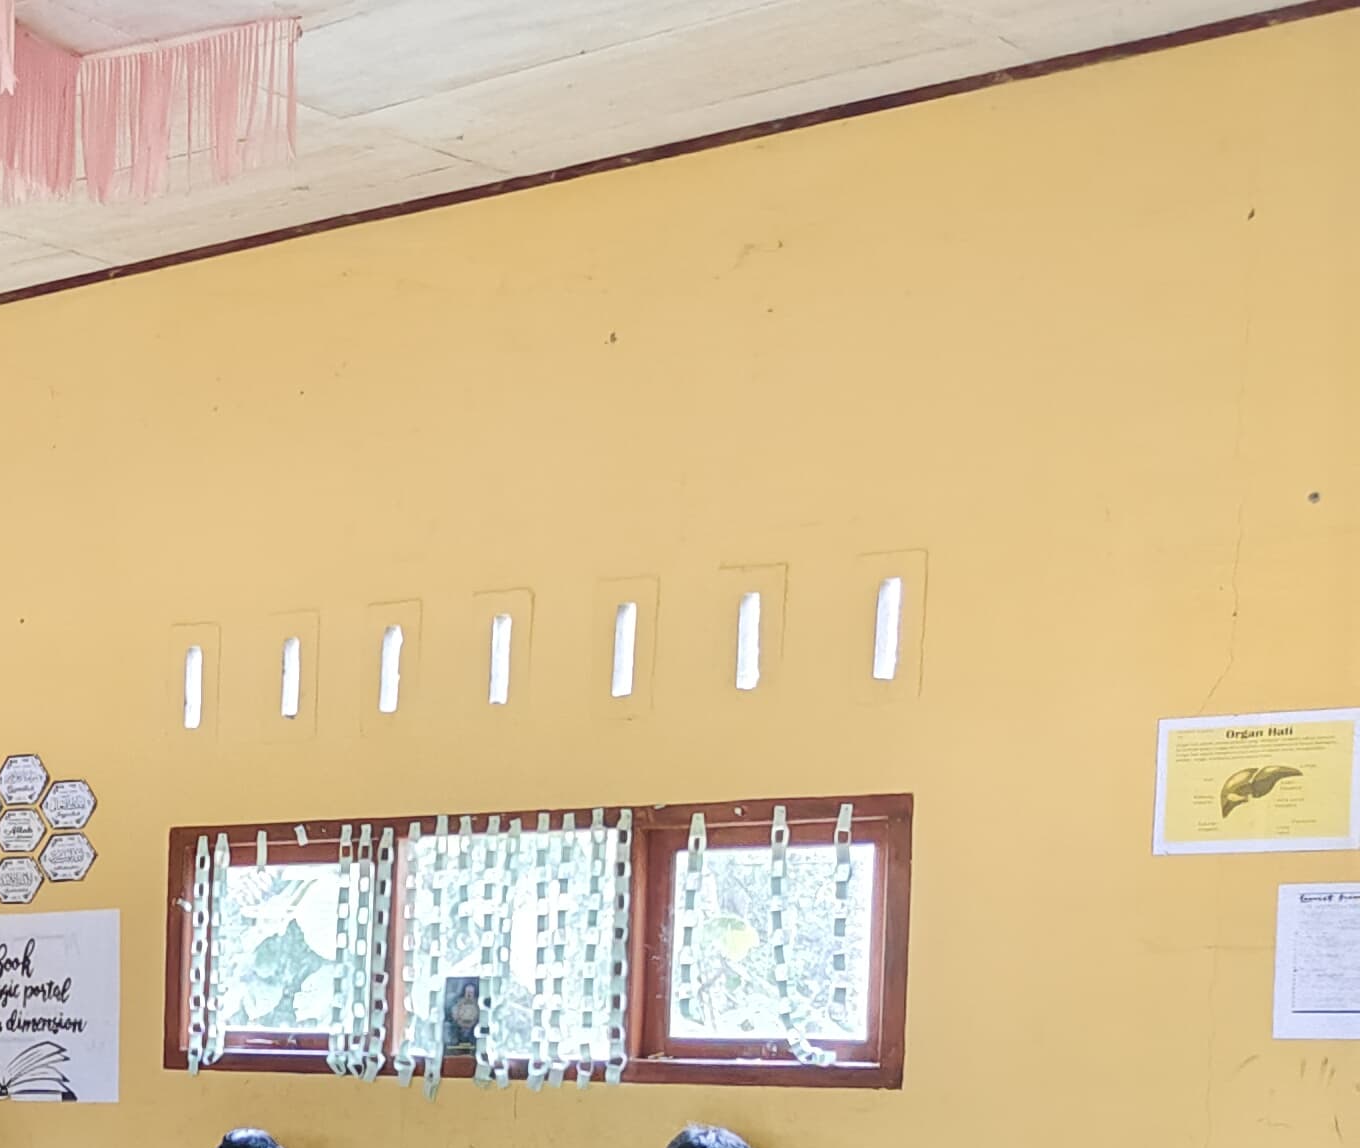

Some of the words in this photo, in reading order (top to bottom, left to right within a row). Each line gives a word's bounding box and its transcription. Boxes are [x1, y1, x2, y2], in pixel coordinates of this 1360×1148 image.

[1226, 728, 1263, 739] Organ
[23, 977, 72, 1008] portal
[6, 1009, 87, 1034] dimension
